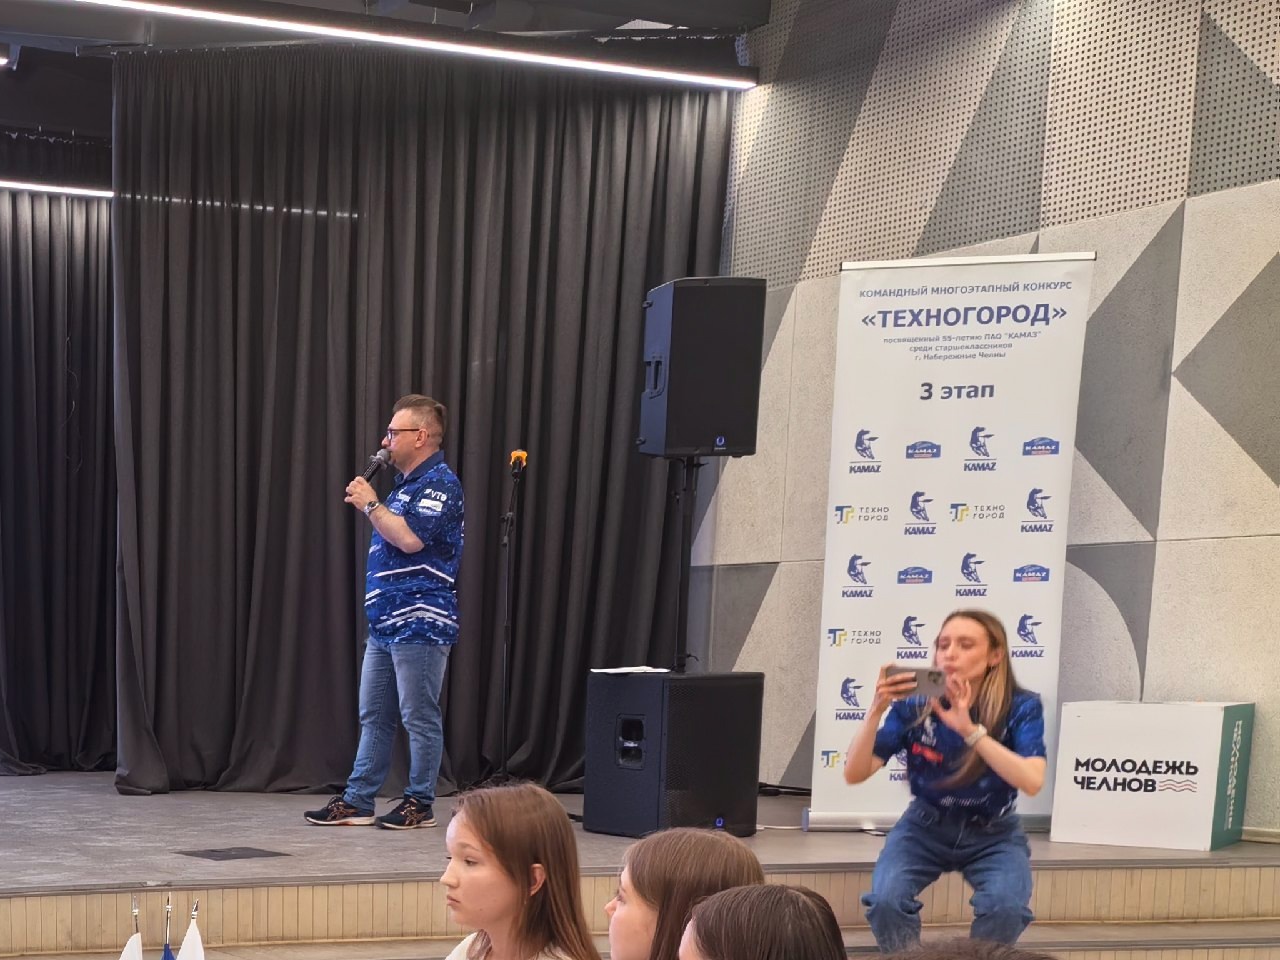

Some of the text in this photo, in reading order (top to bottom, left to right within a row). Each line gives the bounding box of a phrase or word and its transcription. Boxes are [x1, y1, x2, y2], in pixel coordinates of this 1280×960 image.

[860, 281, 1072, 298] КОМАНДНЫЙ МНОГОЭТАПНЫЙ КОНКУРС
[862, 304, 1067, 328] «ТЕХНОГОРОД»
[920, 382, 995, 400] 3 этап
[849, 464, 881, 474] KAMAZ
[964, 462, 996, 471] KAMAZ
[431, 490, 447, 502] VTB
[904, 526, 936, 535] KAMAZ
[1021, 523, 1053, 533] KAMAZ
[842, 589, 874, 598] KAMAZ
[956, 588, 987, 597] KAMAZ
[897, 650, 928, 659] KAMAZ
[1012, 649, 1044, 658] KAMAZ
[835, 711, 866, 721] KAMAZ
[1074, 758, 1198, 776] МОЛОДЕЖЬ
[1073, 776, 1156, 792] ЧЕЛНОВ
